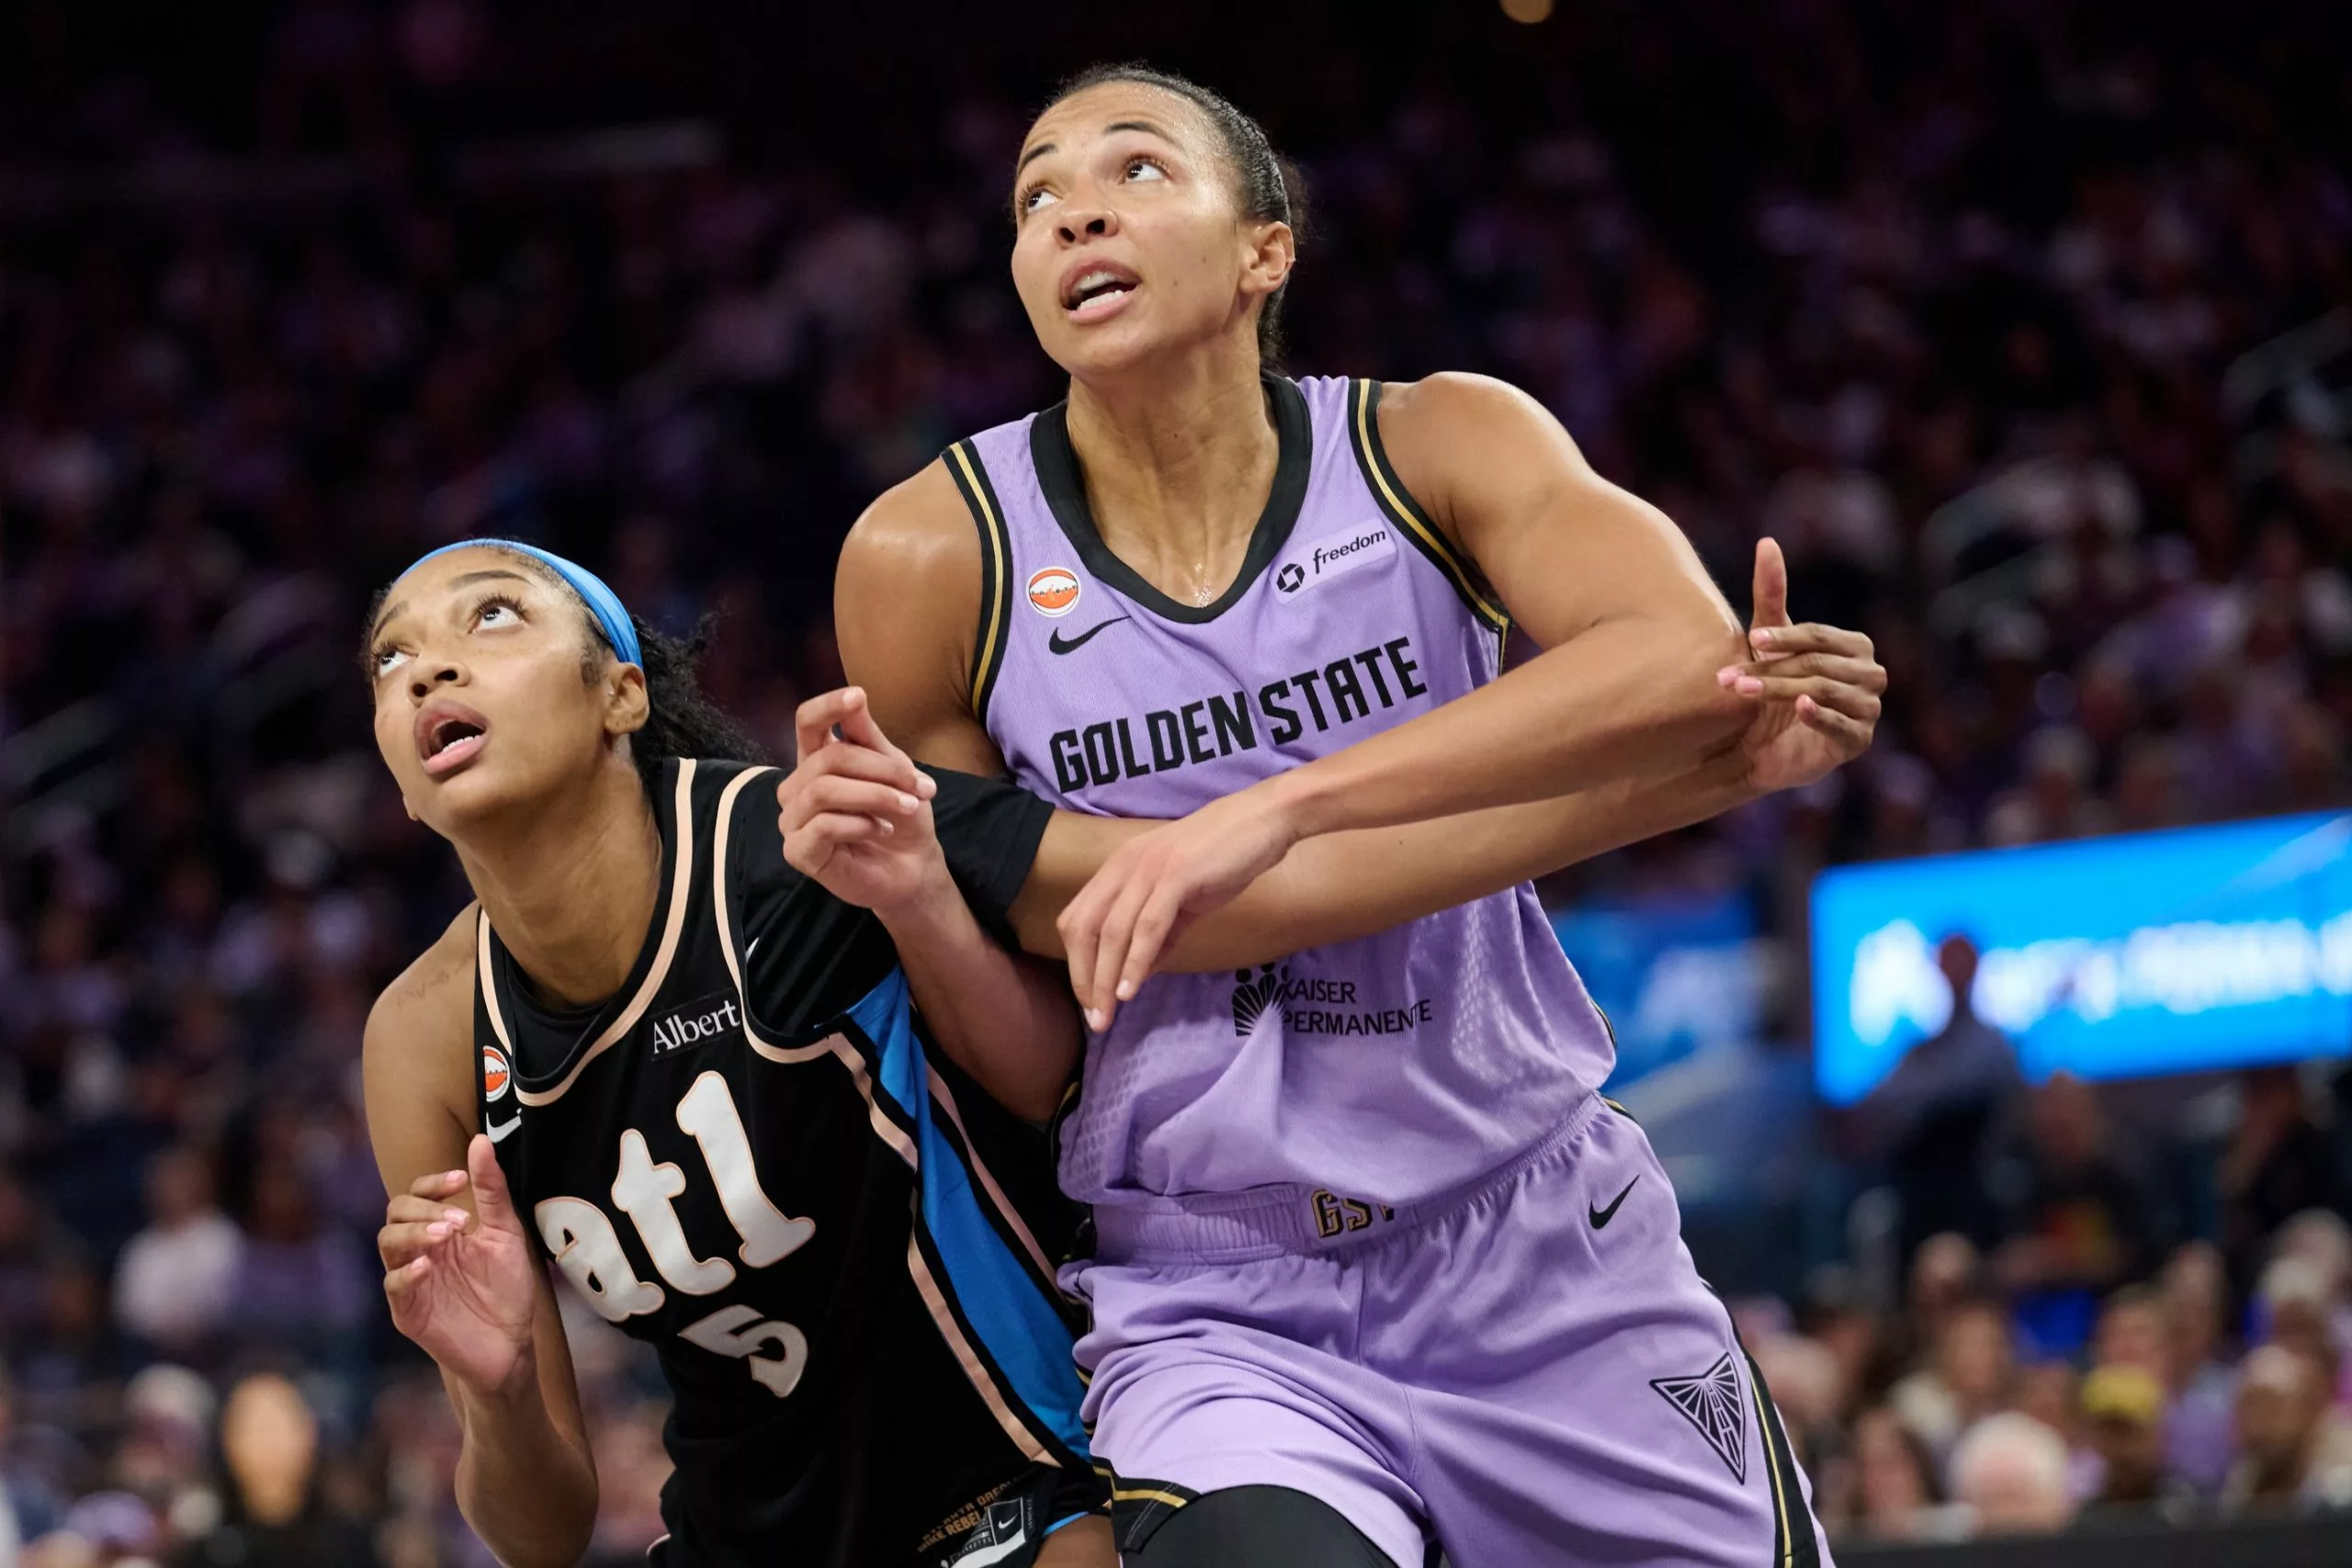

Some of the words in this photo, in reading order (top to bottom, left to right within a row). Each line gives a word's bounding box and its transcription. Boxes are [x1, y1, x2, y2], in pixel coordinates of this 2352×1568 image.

[1312, 530, 1386, 575] freedom
[1049, 691, 1257, 794] GOLDEN
[1258, 637, 1427, 746] STATE
[653, 999, 741, 1055] Albert
[534, 1070, 816, 1323] atl
[1311, 1189, 1395, 1238] GS
[677, 1303, 808, 1398] 5
